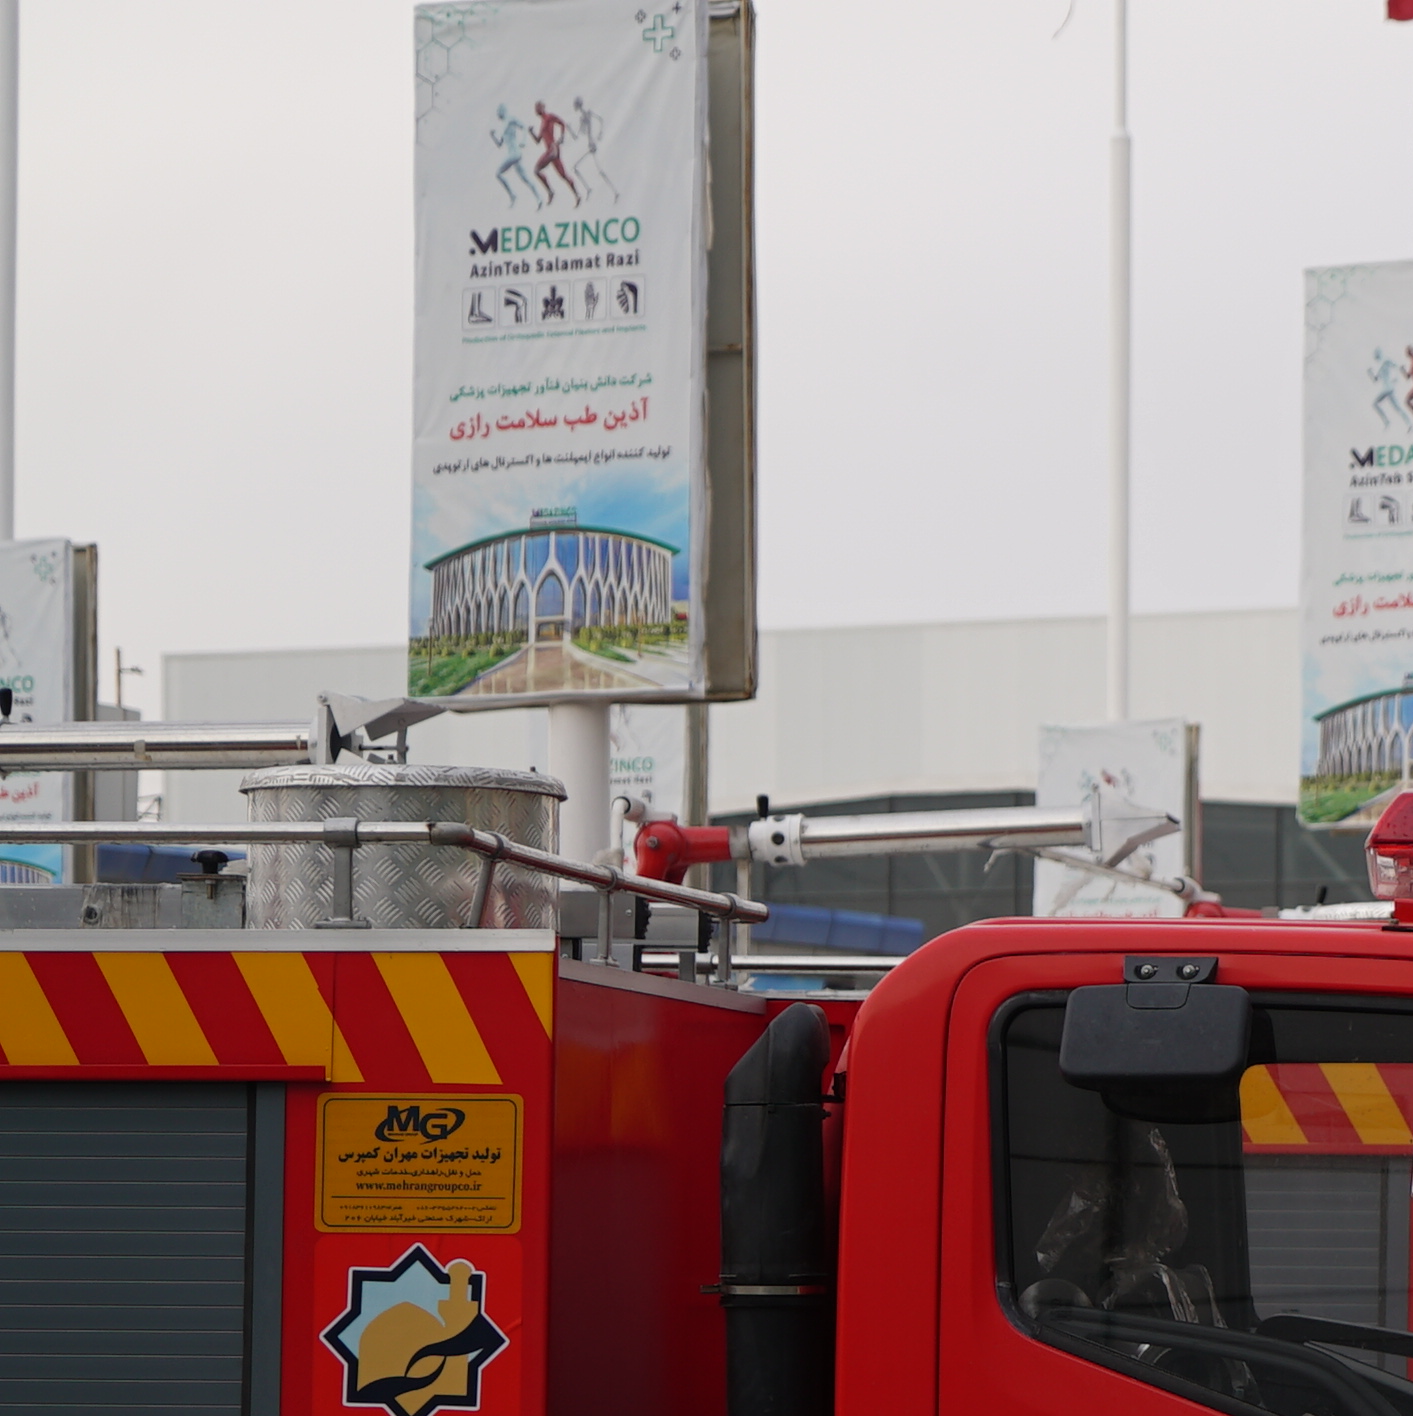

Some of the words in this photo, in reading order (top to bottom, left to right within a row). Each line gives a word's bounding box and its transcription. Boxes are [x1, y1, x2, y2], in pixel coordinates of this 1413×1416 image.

[469, 216, 640, 256] MEDAZINCO
[469, 258, 530, 279] AzinTeb
[535, 253, 601, 273] Salamat
[605, 248, 640, 267] Razi
[449, 411, 491, 441] رازی
[495, 407, 558, 431] سلامت
[563, 403, 598, 433] طب
[602, 396, 650, 430] آذین
[387, 1105, 449, 1139] MG
[338, 1147, 381, 1163] کمپرس
[383, 1147, 418, 1163] مهران
[420, 1147, 469, 1163] تجهیزات
[471, 1147, 501, 1163] تولید
